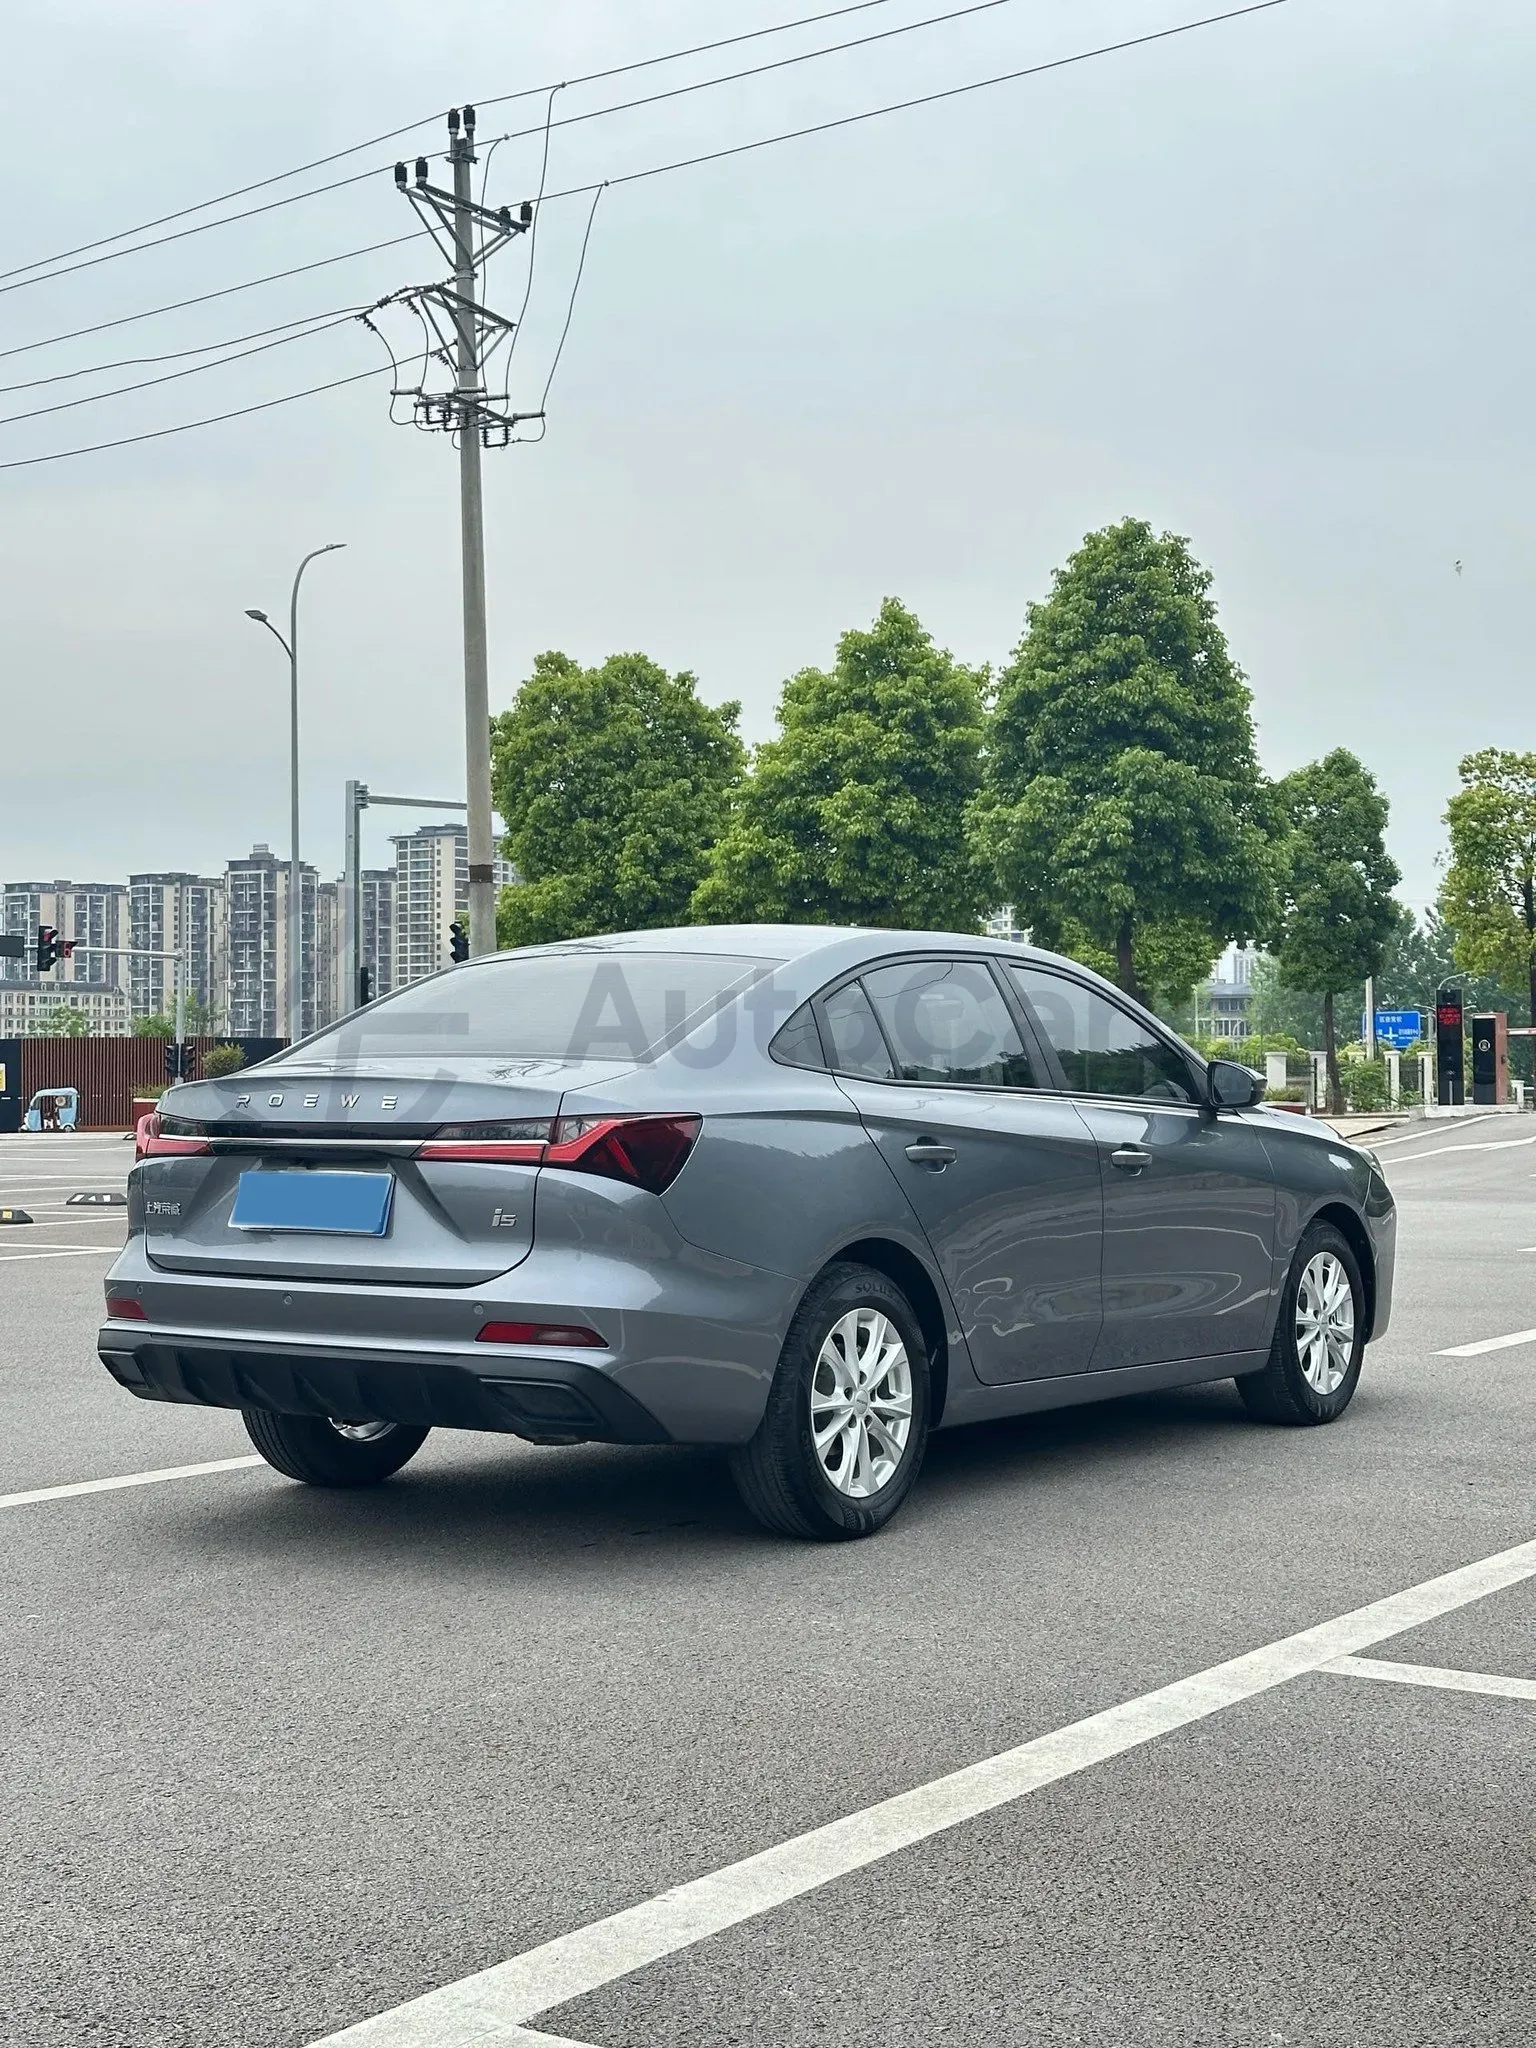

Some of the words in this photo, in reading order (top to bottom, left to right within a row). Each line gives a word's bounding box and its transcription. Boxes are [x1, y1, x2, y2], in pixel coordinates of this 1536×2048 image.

[236, 1093, 399, 1111] ROEWE
[145, 1201, 181, 1216] 上汽荣威
